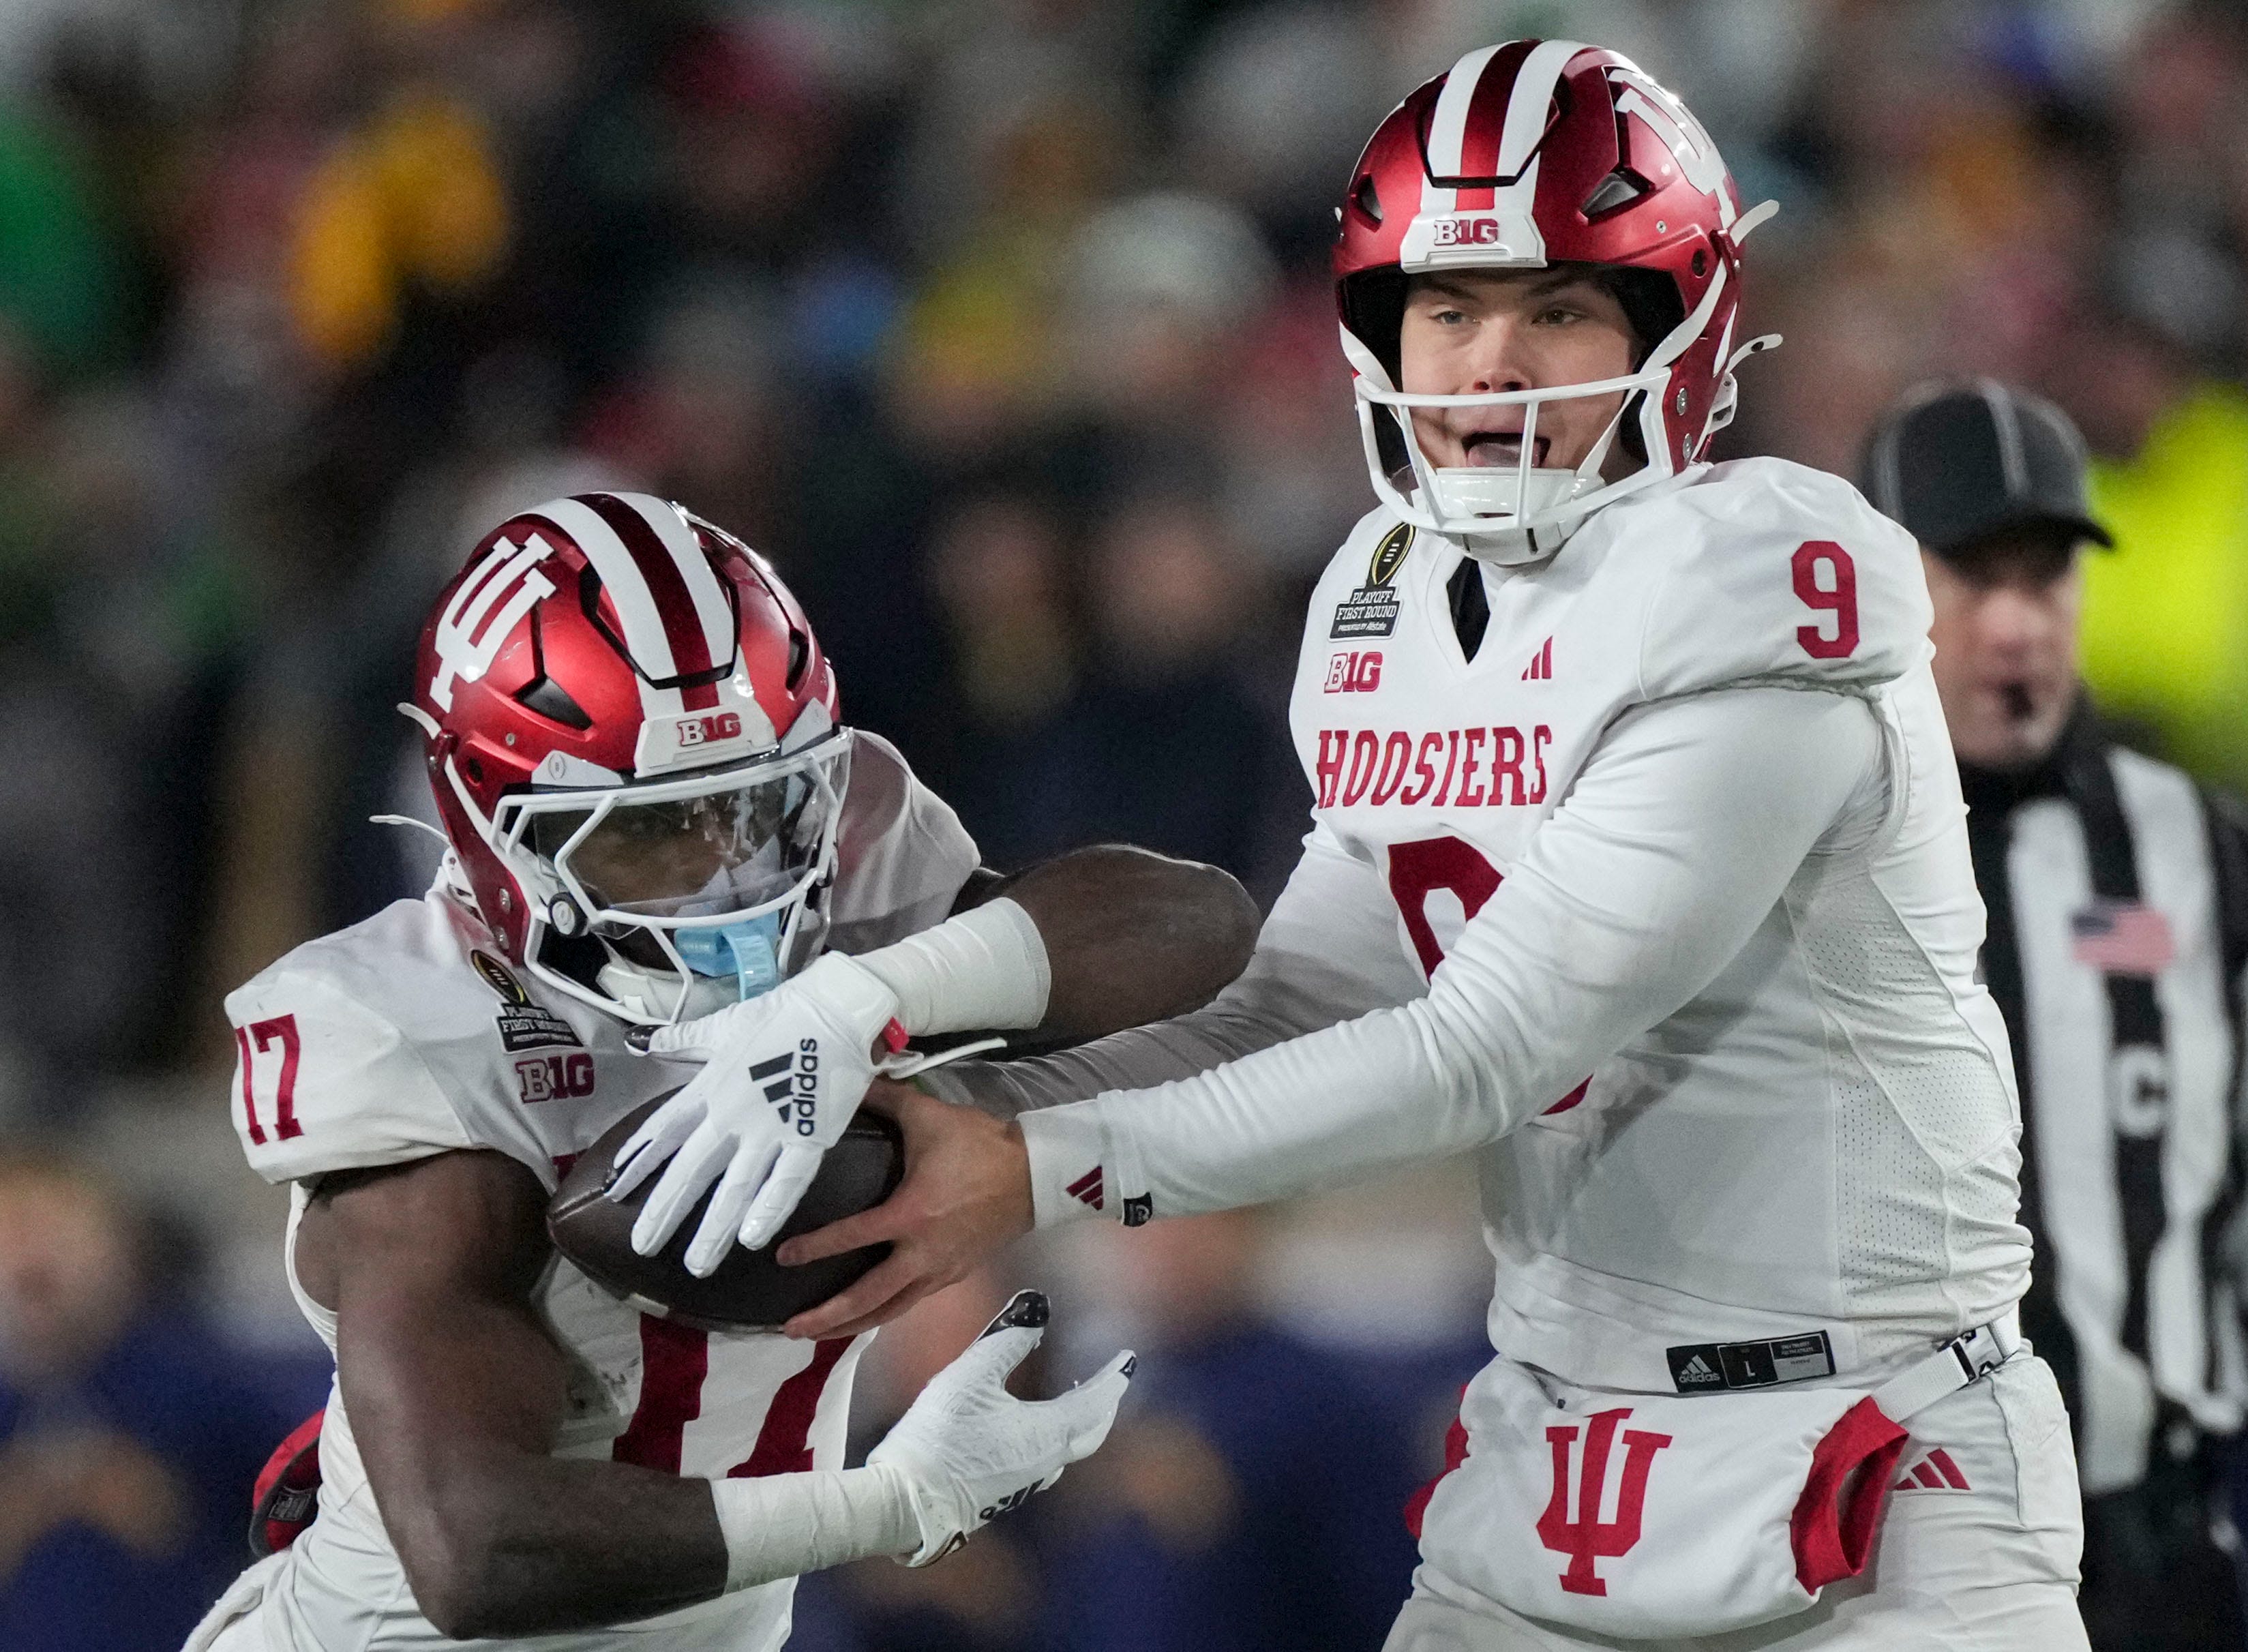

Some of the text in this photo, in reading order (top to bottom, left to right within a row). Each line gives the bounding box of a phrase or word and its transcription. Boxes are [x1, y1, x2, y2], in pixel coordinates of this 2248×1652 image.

[1336, 605, 1397, 620] FIRST ROUND
[1351, 590, 1393, 604] PLAYOFF
[1791, 541, 1859, 659] 9
[1316, 724, 1552, 809] HOOSIERS
[235, 1013, 304, 1146] 17
[792, 1038, 818, 1137] adidas
[1678, 1361, 1756, 1384] adidas L
